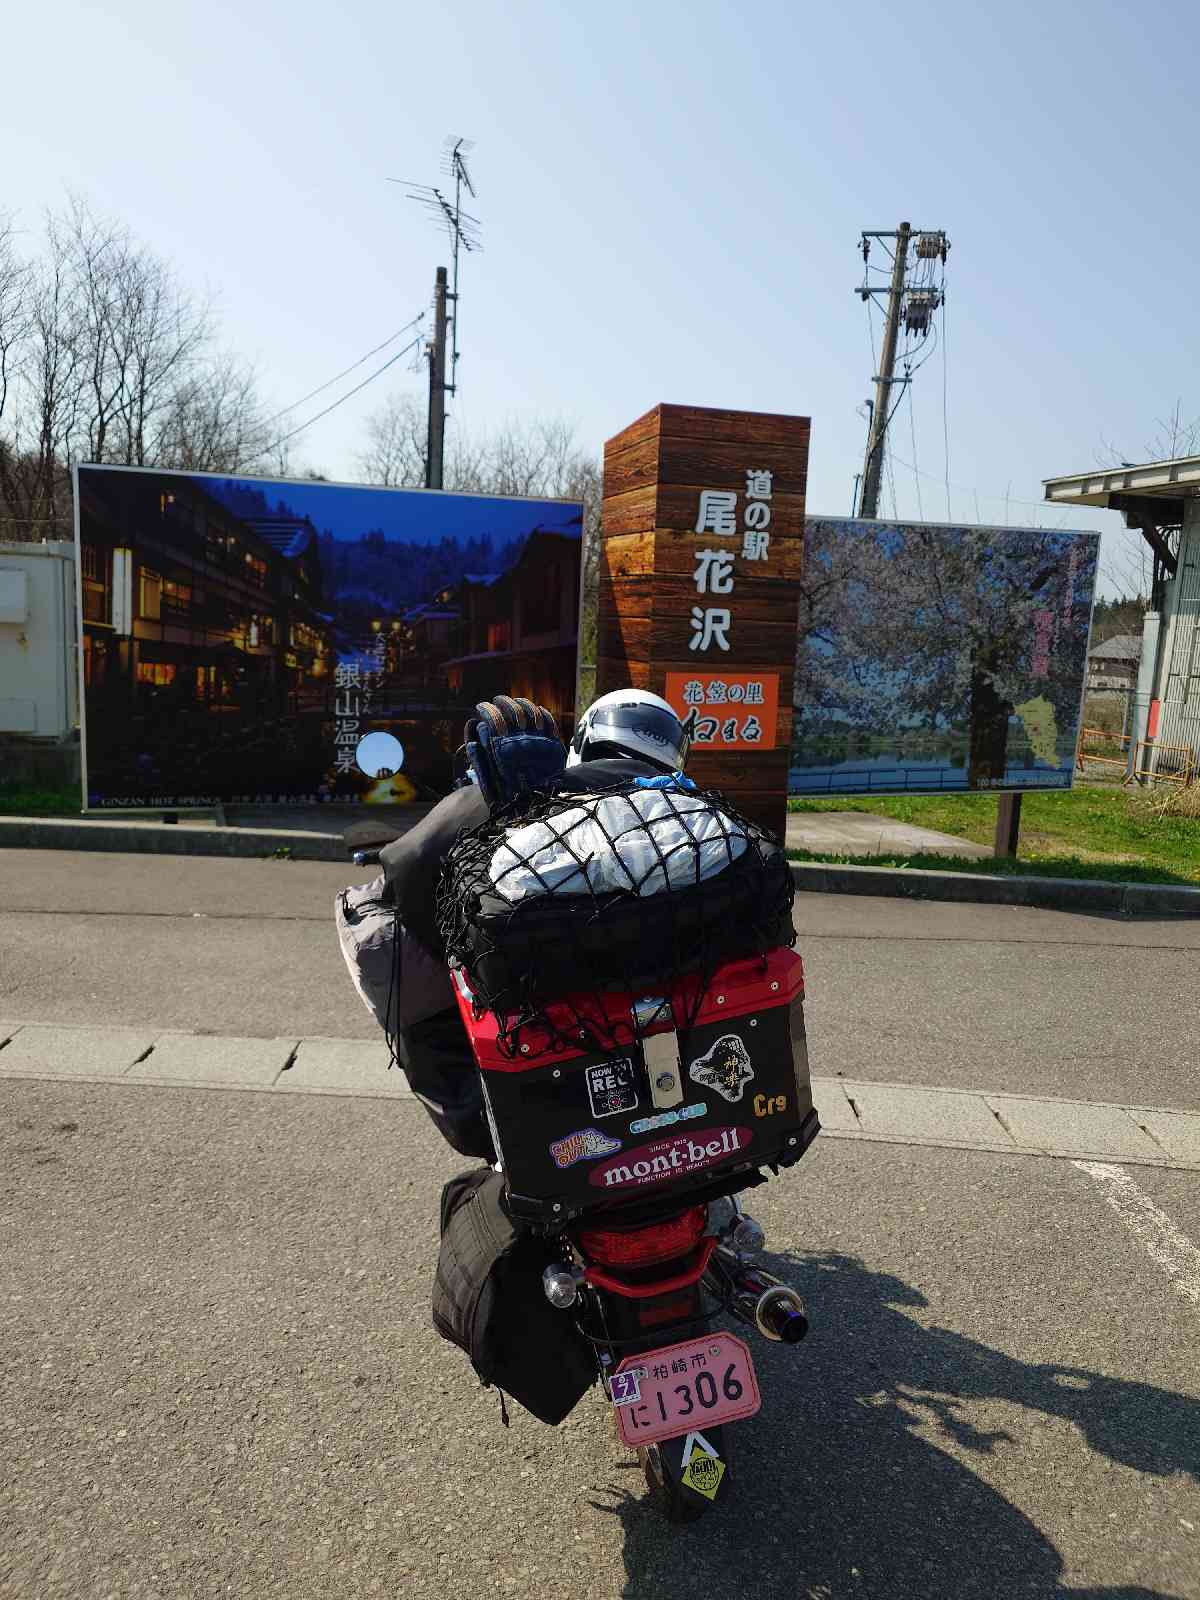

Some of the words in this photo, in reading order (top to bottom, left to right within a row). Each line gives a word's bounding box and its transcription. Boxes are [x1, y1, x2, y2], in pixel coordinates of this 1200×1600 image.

[741, 469, 773, 561] 道の駅
[688, 489, 737, 652] 尾花沢
[333, 661, 361, 774] 銀山温泉
[682, 680, 764, 705] 花笠の里
[591, 1067, 612, 1079] NOW
[630, 1404, 650, 1429] に
[656, 1363, 743, 1421] 1306
[652, 1352, 707, 1381] 柏崎市
